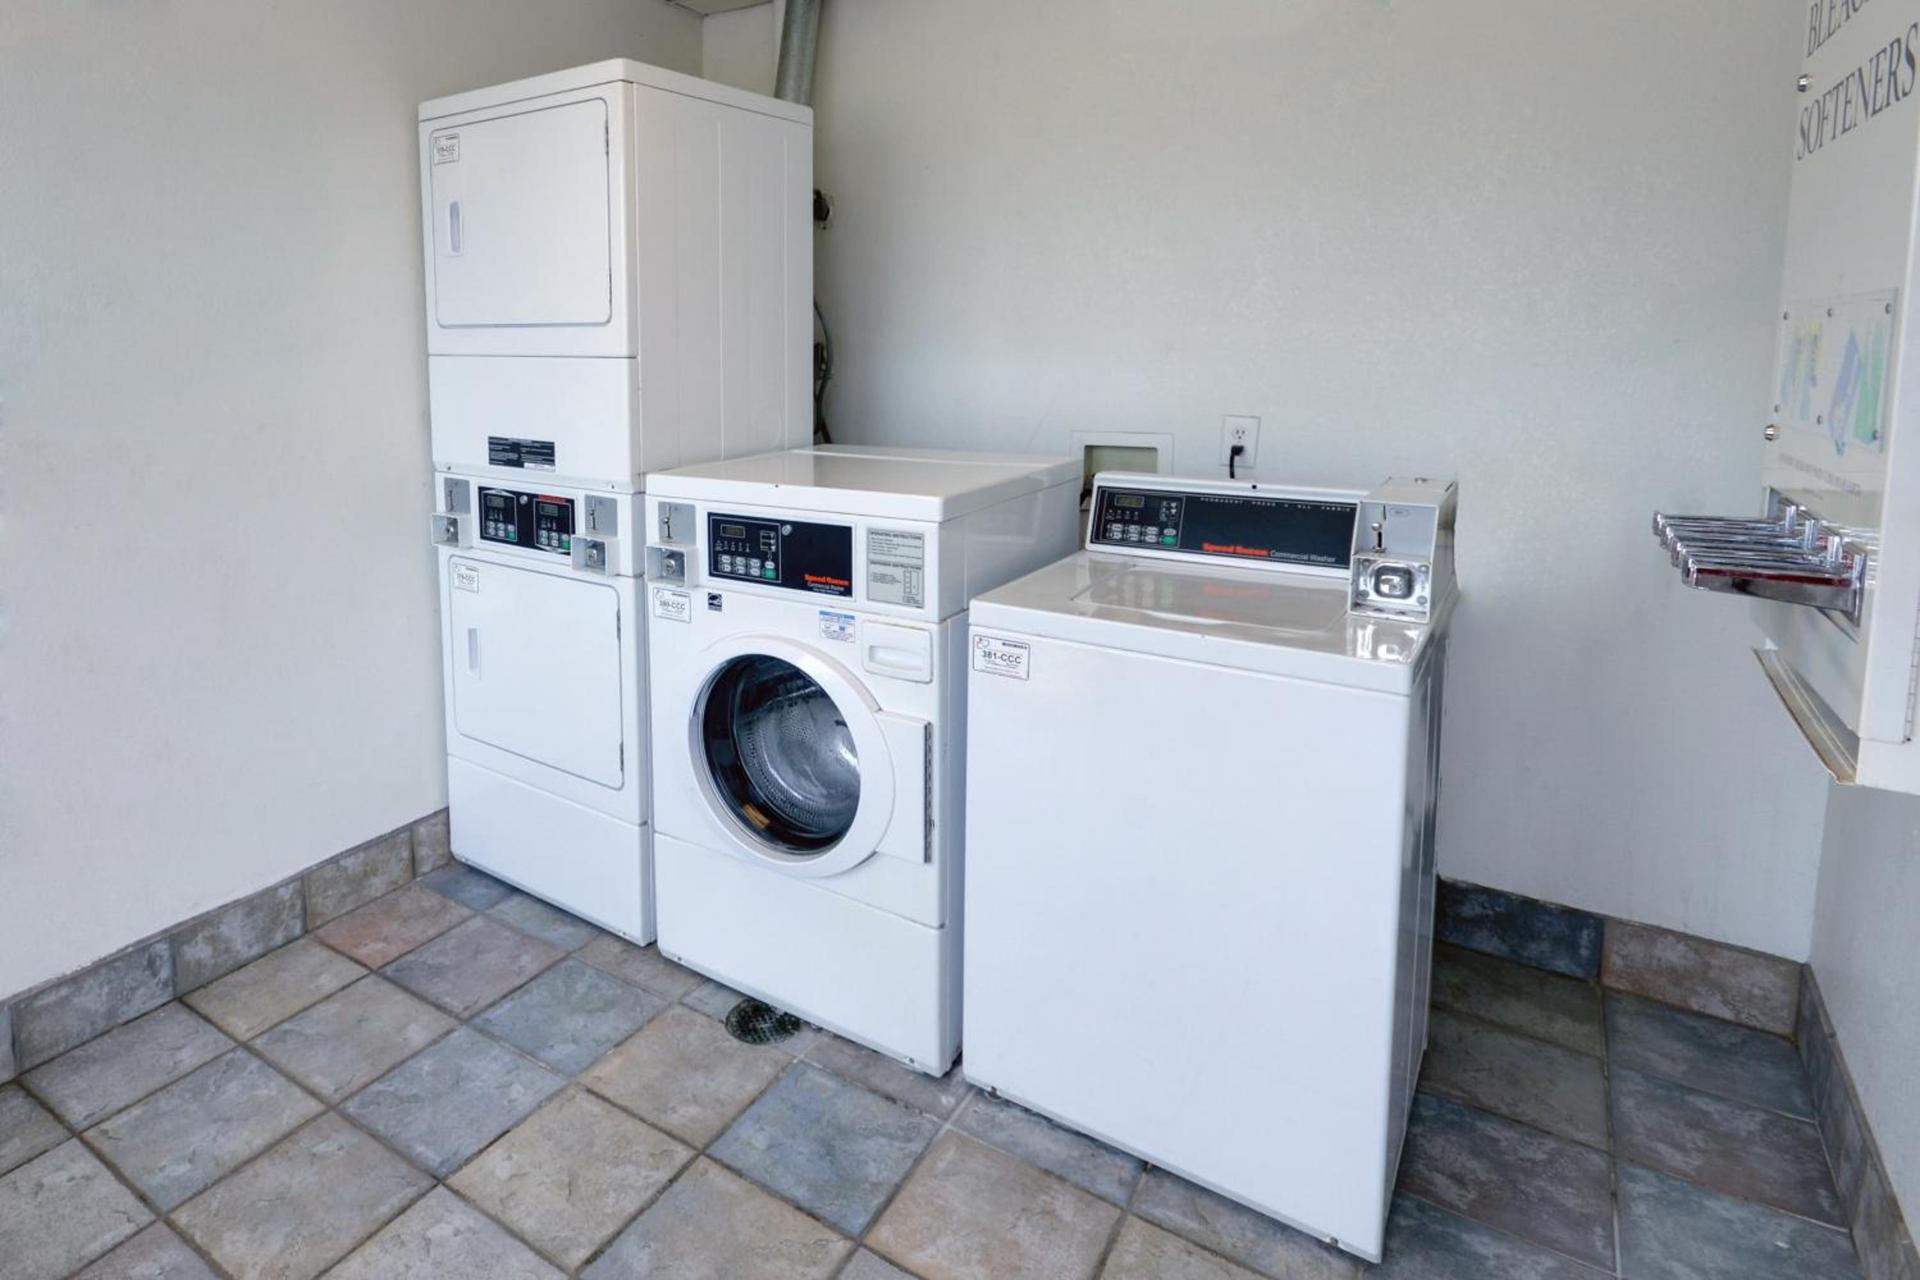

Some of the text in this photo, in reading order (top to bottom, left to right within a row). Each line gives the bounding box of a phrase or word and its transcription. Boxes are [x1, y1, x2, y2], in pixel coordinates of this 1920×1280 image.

[1806, 0, 1866, 58] BLE
[1797, 22, 1918, 161] SOFTENERS
[981, 650, 1022, 664] 381-CCC
